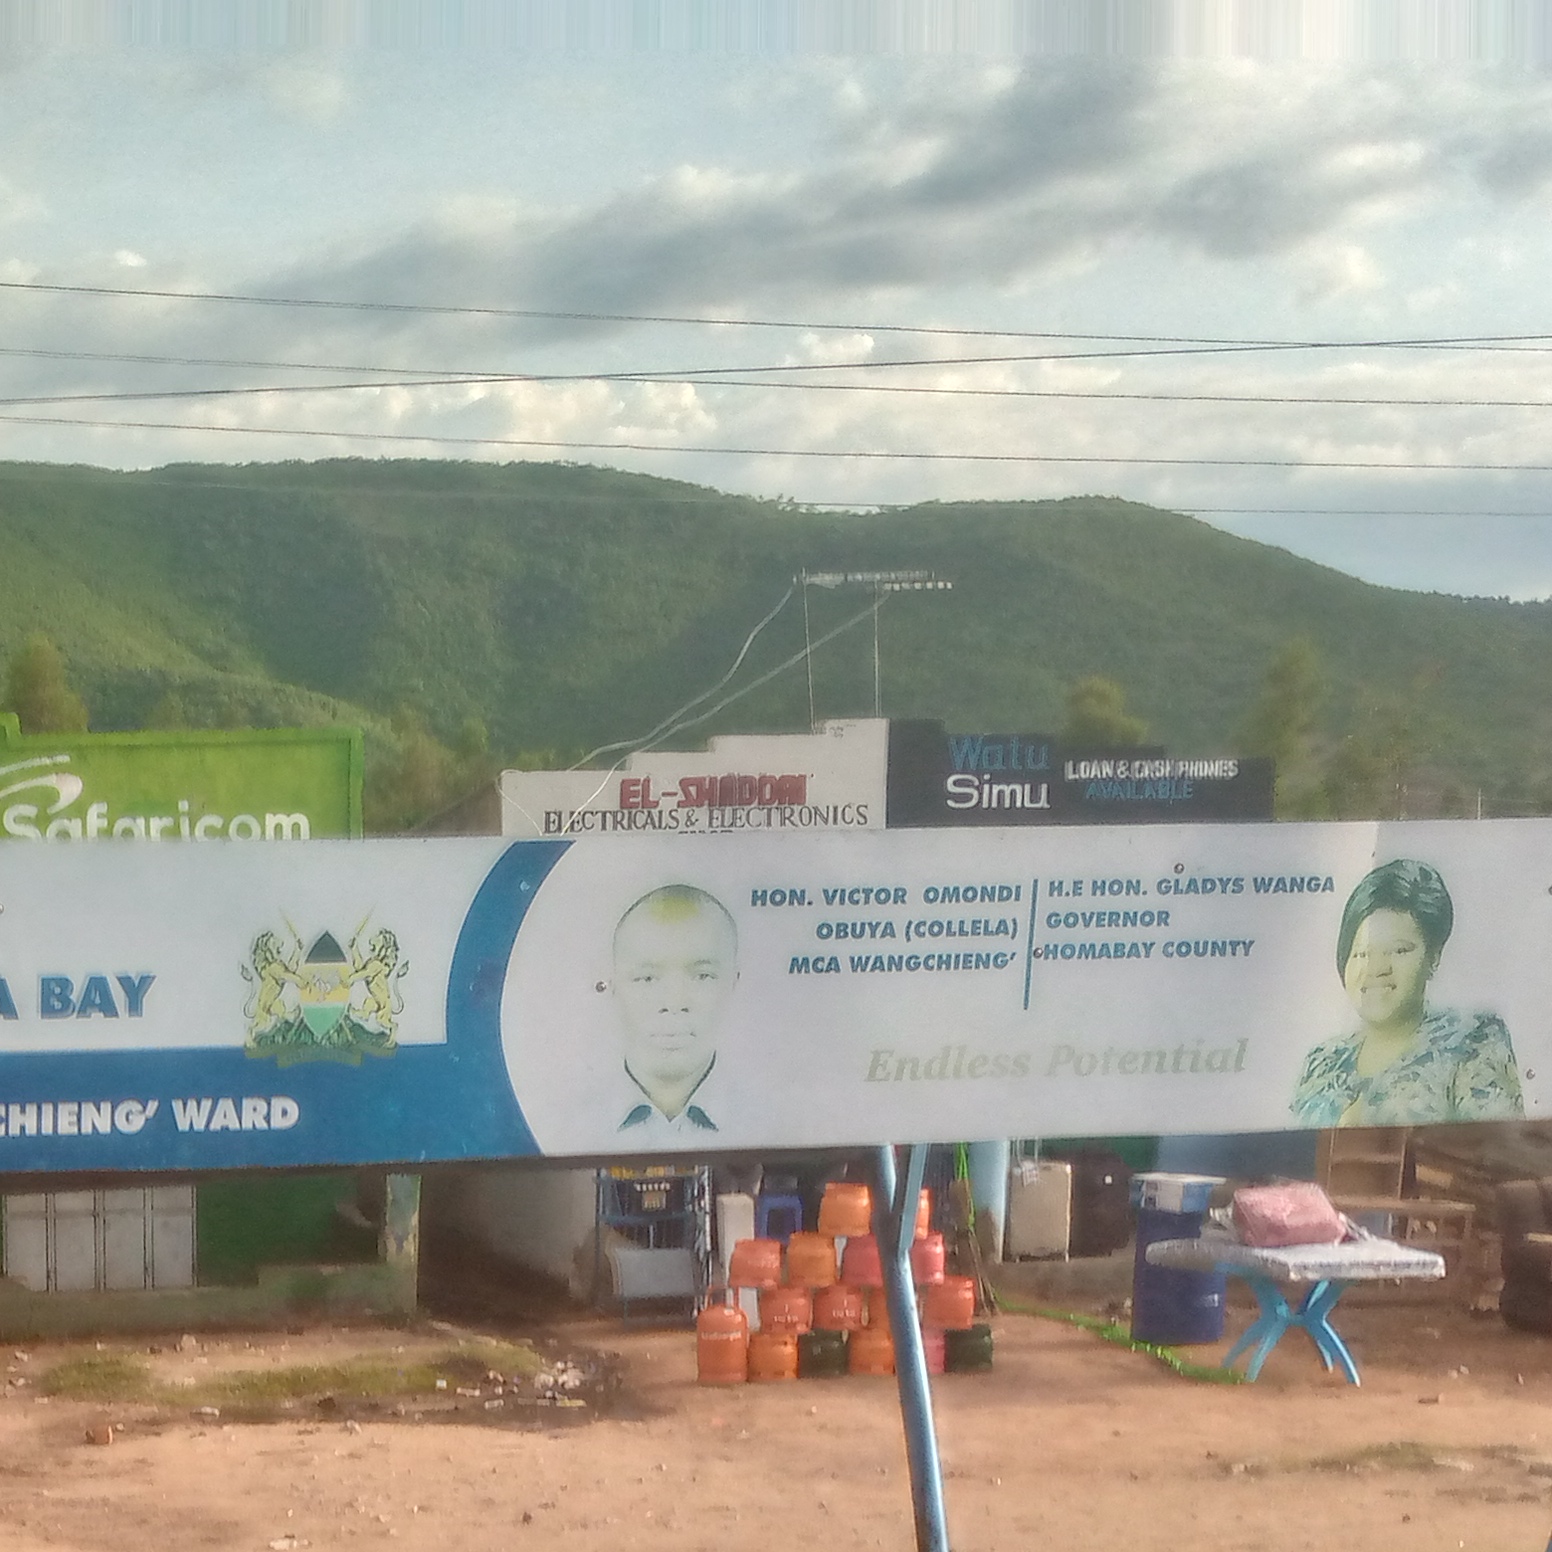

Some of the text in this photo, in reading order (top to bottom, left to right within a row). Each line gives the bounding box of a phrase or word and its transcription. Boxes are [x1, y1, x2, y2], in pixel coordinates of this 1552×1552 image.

[949, 736, 1049, 770] Watu
[1065, 759, 1114, 780] LOAN
[946, 772, 1050, 810] Simu
[1085, 779, 1194, 800] AVAILABLE
[2, 799, 311, 841] Safaricom
[684, 808, 700, 829] &
[751, 885, 1021, 906] HON. VICTOR OMONDI
[1048, 876, 1335, 897] H.E HON. GLADYS WANGA
[816, 917, 1018, 942] OBUYA (COLLELA)
[1045, 910, 1170, 929] GOVERNOR
[1043, 940, 1255, 960] HOMABAY COUNTY
[789, 956, 841, 974] MCA
[39, 974, 156, 1019] BAY
[864, 1038, 1249, 1082] Endless Potential
[172, 1097, 300, 1131] WARD
